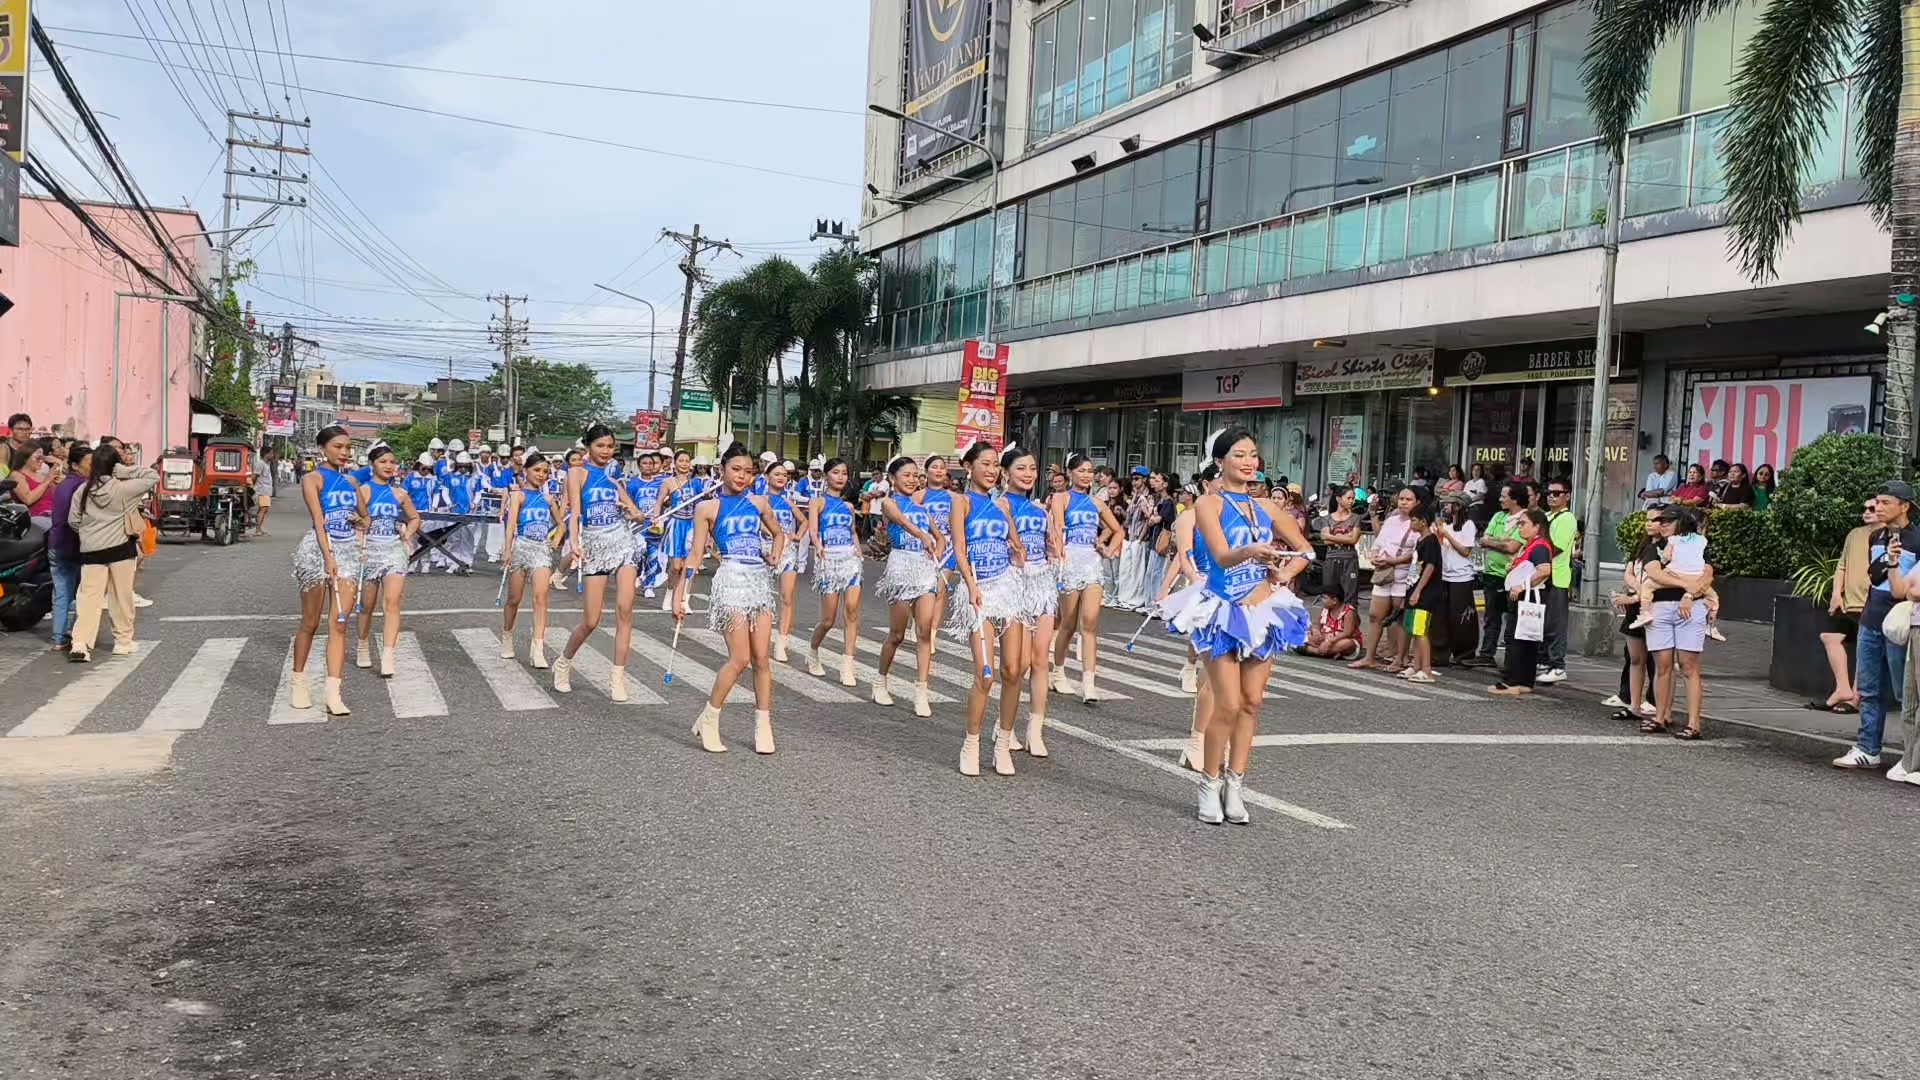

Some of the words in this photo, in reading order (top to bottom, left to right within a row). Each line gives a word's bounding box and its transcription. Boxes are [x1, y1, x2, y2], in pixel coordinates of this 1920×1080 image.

[1302, 360, 1338, 380] Bicol
[1342, 358, 1386, 376] Shirts
[1391, 352, 1428, 372] City
[1528, 351, 1571, 369] BARBER
[1577, 349, 1598, 366] SHO
[973, 366, 999, 380] BIG
[1550, 370, 1578, 378] POMADE
[970, 382, 997, 393] SALE
[1216, 374, 1240, 393] TGP
[961, 407, 990, 427] 70
[1476, 447, 1506, 462] FADE
[1525, 447, 1569, 462] POADE
[1585, 446, 1628, 461] SAVE
[370, 503, 399, 517] TCI
[1015, 515, 1047, 532] TCI
